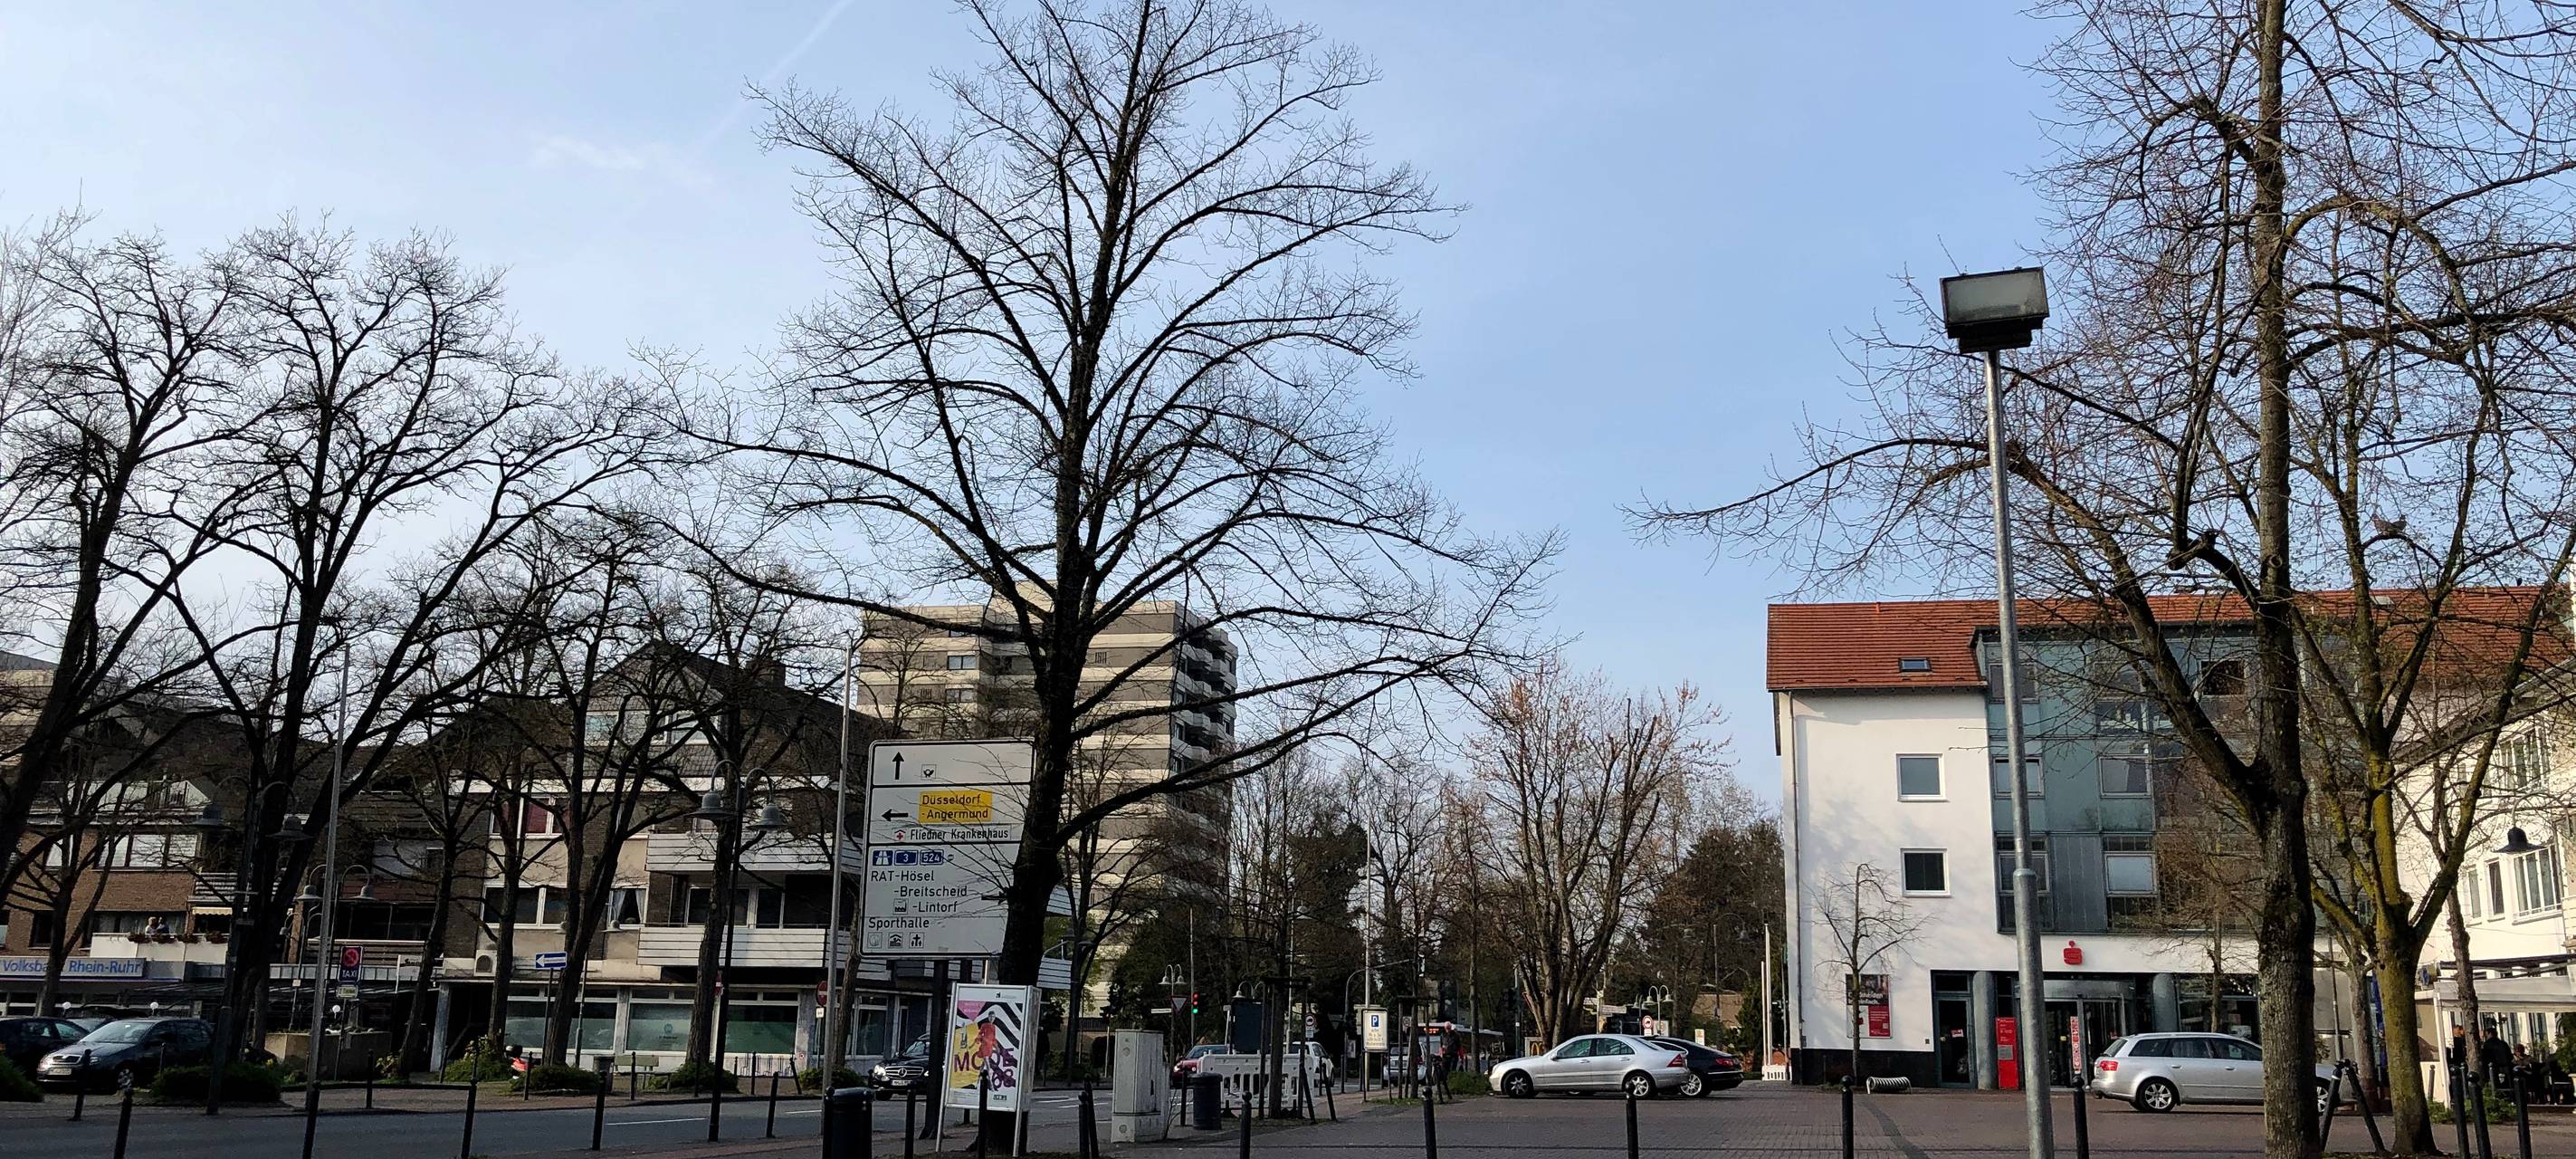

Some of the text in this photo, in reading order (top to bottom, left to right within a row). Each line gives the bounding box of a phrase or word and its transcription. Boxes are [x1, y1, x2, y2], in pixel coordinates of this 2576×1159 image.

[922, 793, 981, 805] Düsseldorf
[910, 828, 1008, 840] Fliedner Krankenhaus
[903, 853, 940, 863] 3 524
[871, 870, 934, 881] RAT-Hösel
[893, 886, 968, 896] -Breitscheid
[912, 901, 958, 913] -Lintorf
[868, 917, 930, 931] Sporthalle
[4, 960, 140, 973] Volksba Rhein-Ruhr
[342, 970, 358, 978] TAXI
